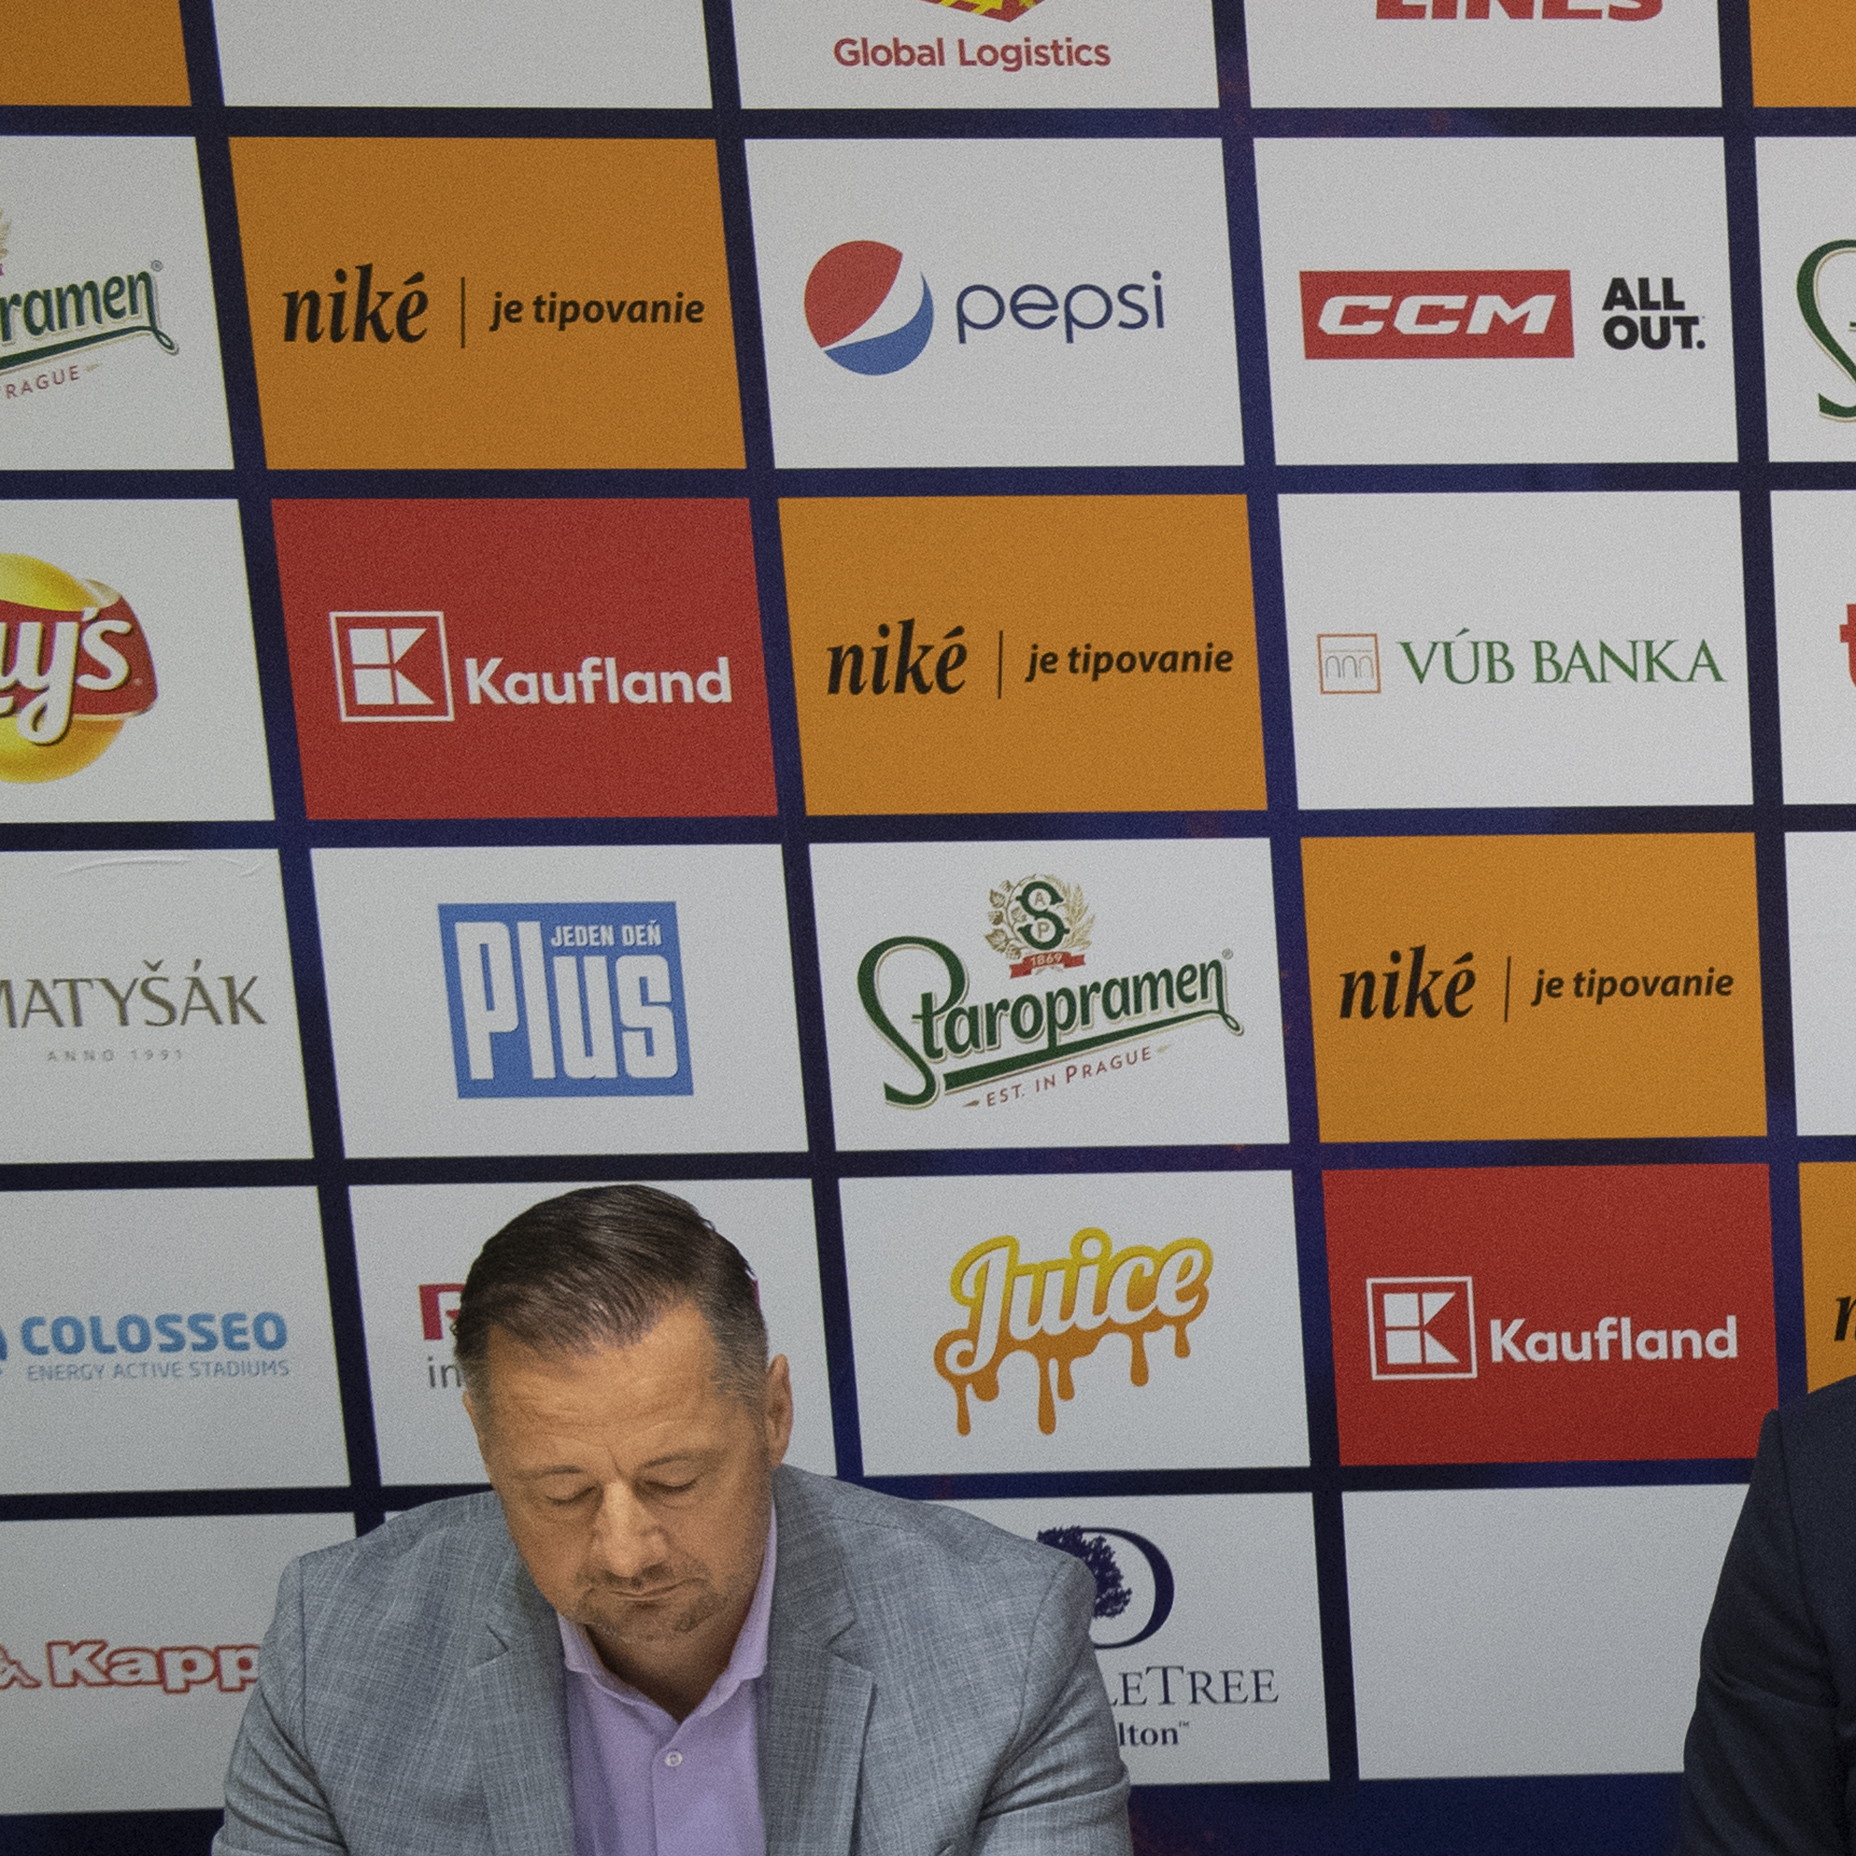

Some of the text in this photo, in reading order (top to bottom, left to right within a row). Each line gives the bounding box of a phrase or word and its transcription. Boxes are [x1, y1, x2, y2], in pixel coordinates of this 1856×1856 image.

[833, 37, 1111, 72] Global Logistics
[283, 264, 704, 343] niké je tipovanie
[956, 270, 1164, 344] pepsi
[1318, 295, 1556, 335] CCM
[1603, 277, 1685, 311] ALL
[1603, 315, 1705, 350] OUT.
[828, 619, 1233, 695] niké je tipovanie
[1400, 628, 1724, 684] VÚB BANKA
[465, 657, 731, 704] Kaufland
[551, 920, 661, 946] JEDEN DEŇ
[453, 920, 681, 1082] Plus
[1340, 945, 1733, 1019] niké je tipovanie
[857, 935, 1247, 1111] Staropramen
[1034, 1072, 1059, 1096] IN
[946, 1228, 1208, 1380] Juice
[21, 1312, 287, 1356] COLOSSEO
[1490, 1315, 1737, 1362] Kaufland
[27, 1358, 290, 1382] ENERGY ACTIVE STADIUMS
[46, 1639, 259, 1694] Kapp
